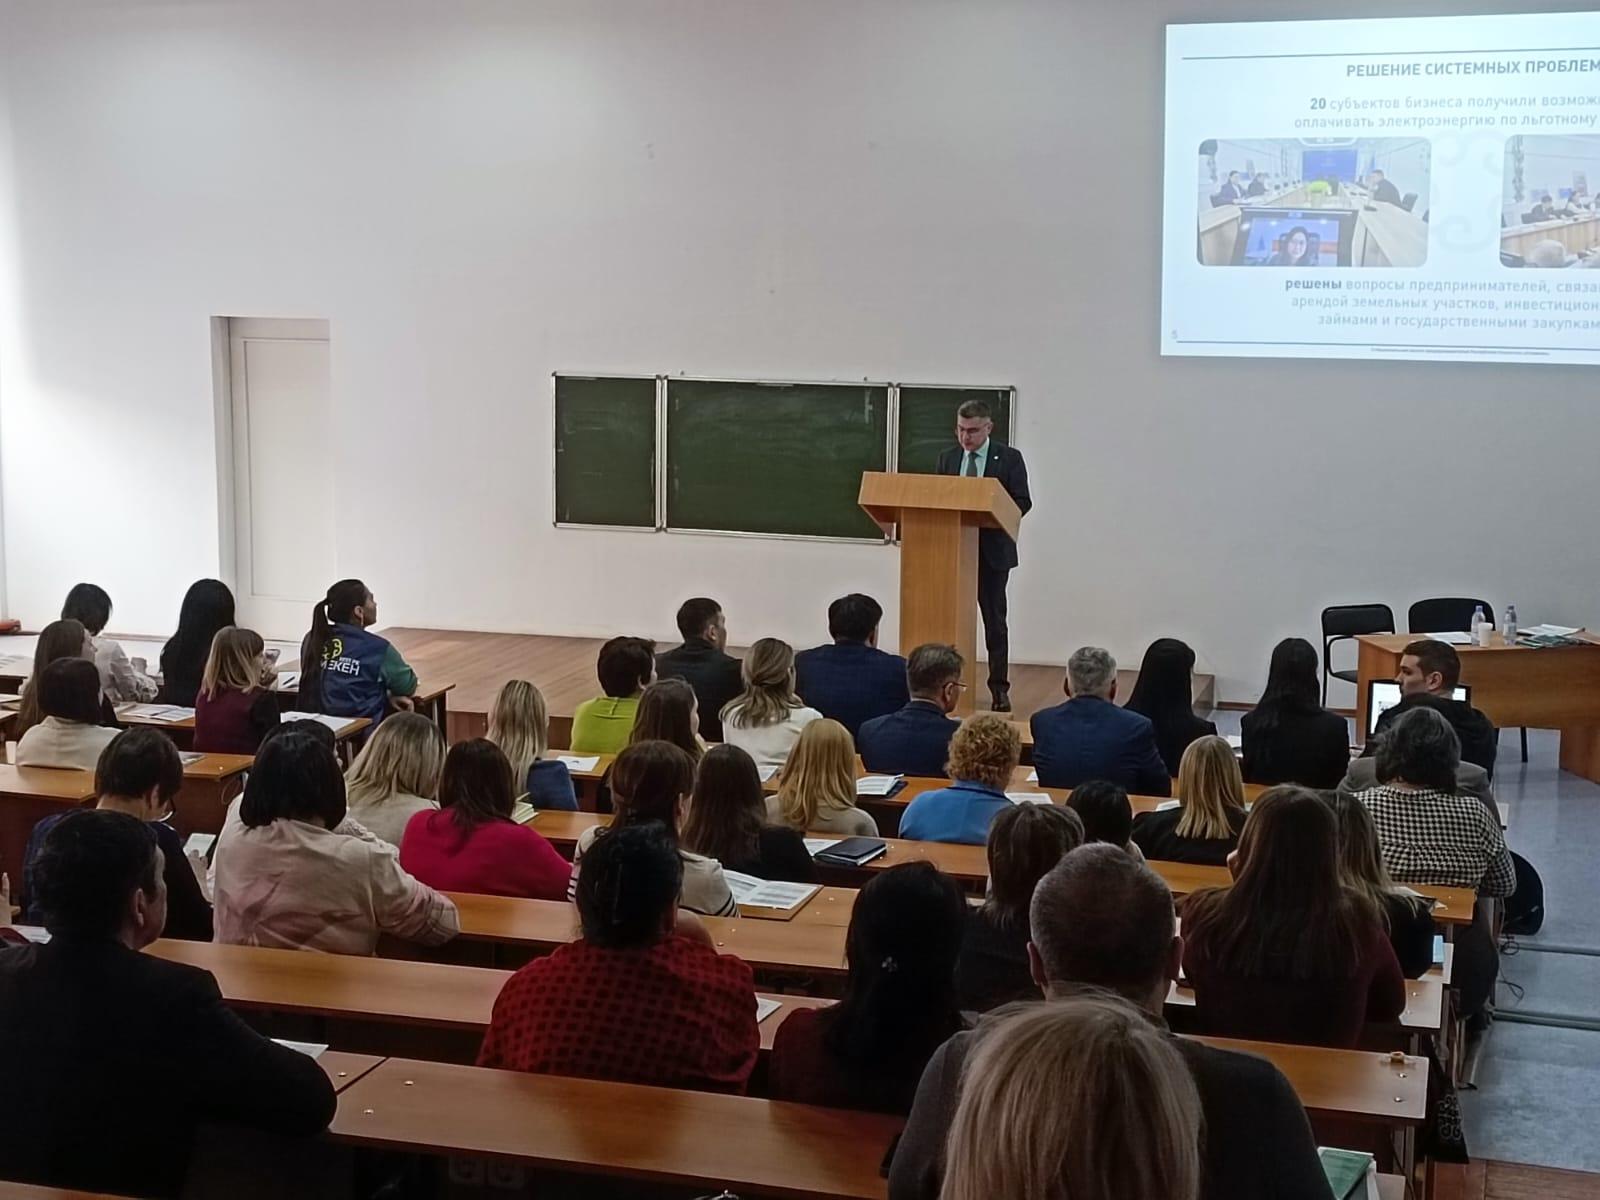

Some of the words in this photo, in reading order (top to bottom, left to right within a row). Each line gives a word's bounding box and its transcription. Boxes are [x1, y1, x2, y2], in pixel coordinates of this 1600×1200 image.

[1346, 63, 1421, 77] РЕШЕНИЕ
[1425, 61, 1520, 76] СИСТЕМНЫХ
[1525, 59, 1600, 74] ПРОБЛЕМ
[1310, 97, 1327, 110] 20
[1329, 96, 1400, 112] субъектов
[1405, 96, 1463, 109] бизнеса
[1467, 95, 1537, 111] получили
[1542, 95, 1600, 107] возмож
[1294, 117, 1375, 129] оплачивать
[1378, 115, 1496, 130] электроэнергию
[1500, 115, 1517, 126] по
[1521, 113, 1597, 127] льготному
[1285, 279, 1342, 292] решены
[1346, 279, 1405, 292] вопросы
[1409, 279, 1551, 294] предпринимателей,
[1556, 282, 1600, 294] связа
[1291, 295, 1348, 310] арендой
[1351, 298, 1428, 309] земельных
[1433, 299, 1499, 312] участков,
[1504, 299, 1599, 312] инвестицион
[1317, 313, 1378, 325] займами
[1382, 315, 1390, 326] и
[1394, 315, 1527, 329] государственными
[1532, 317, 1600, 332] закупкам
